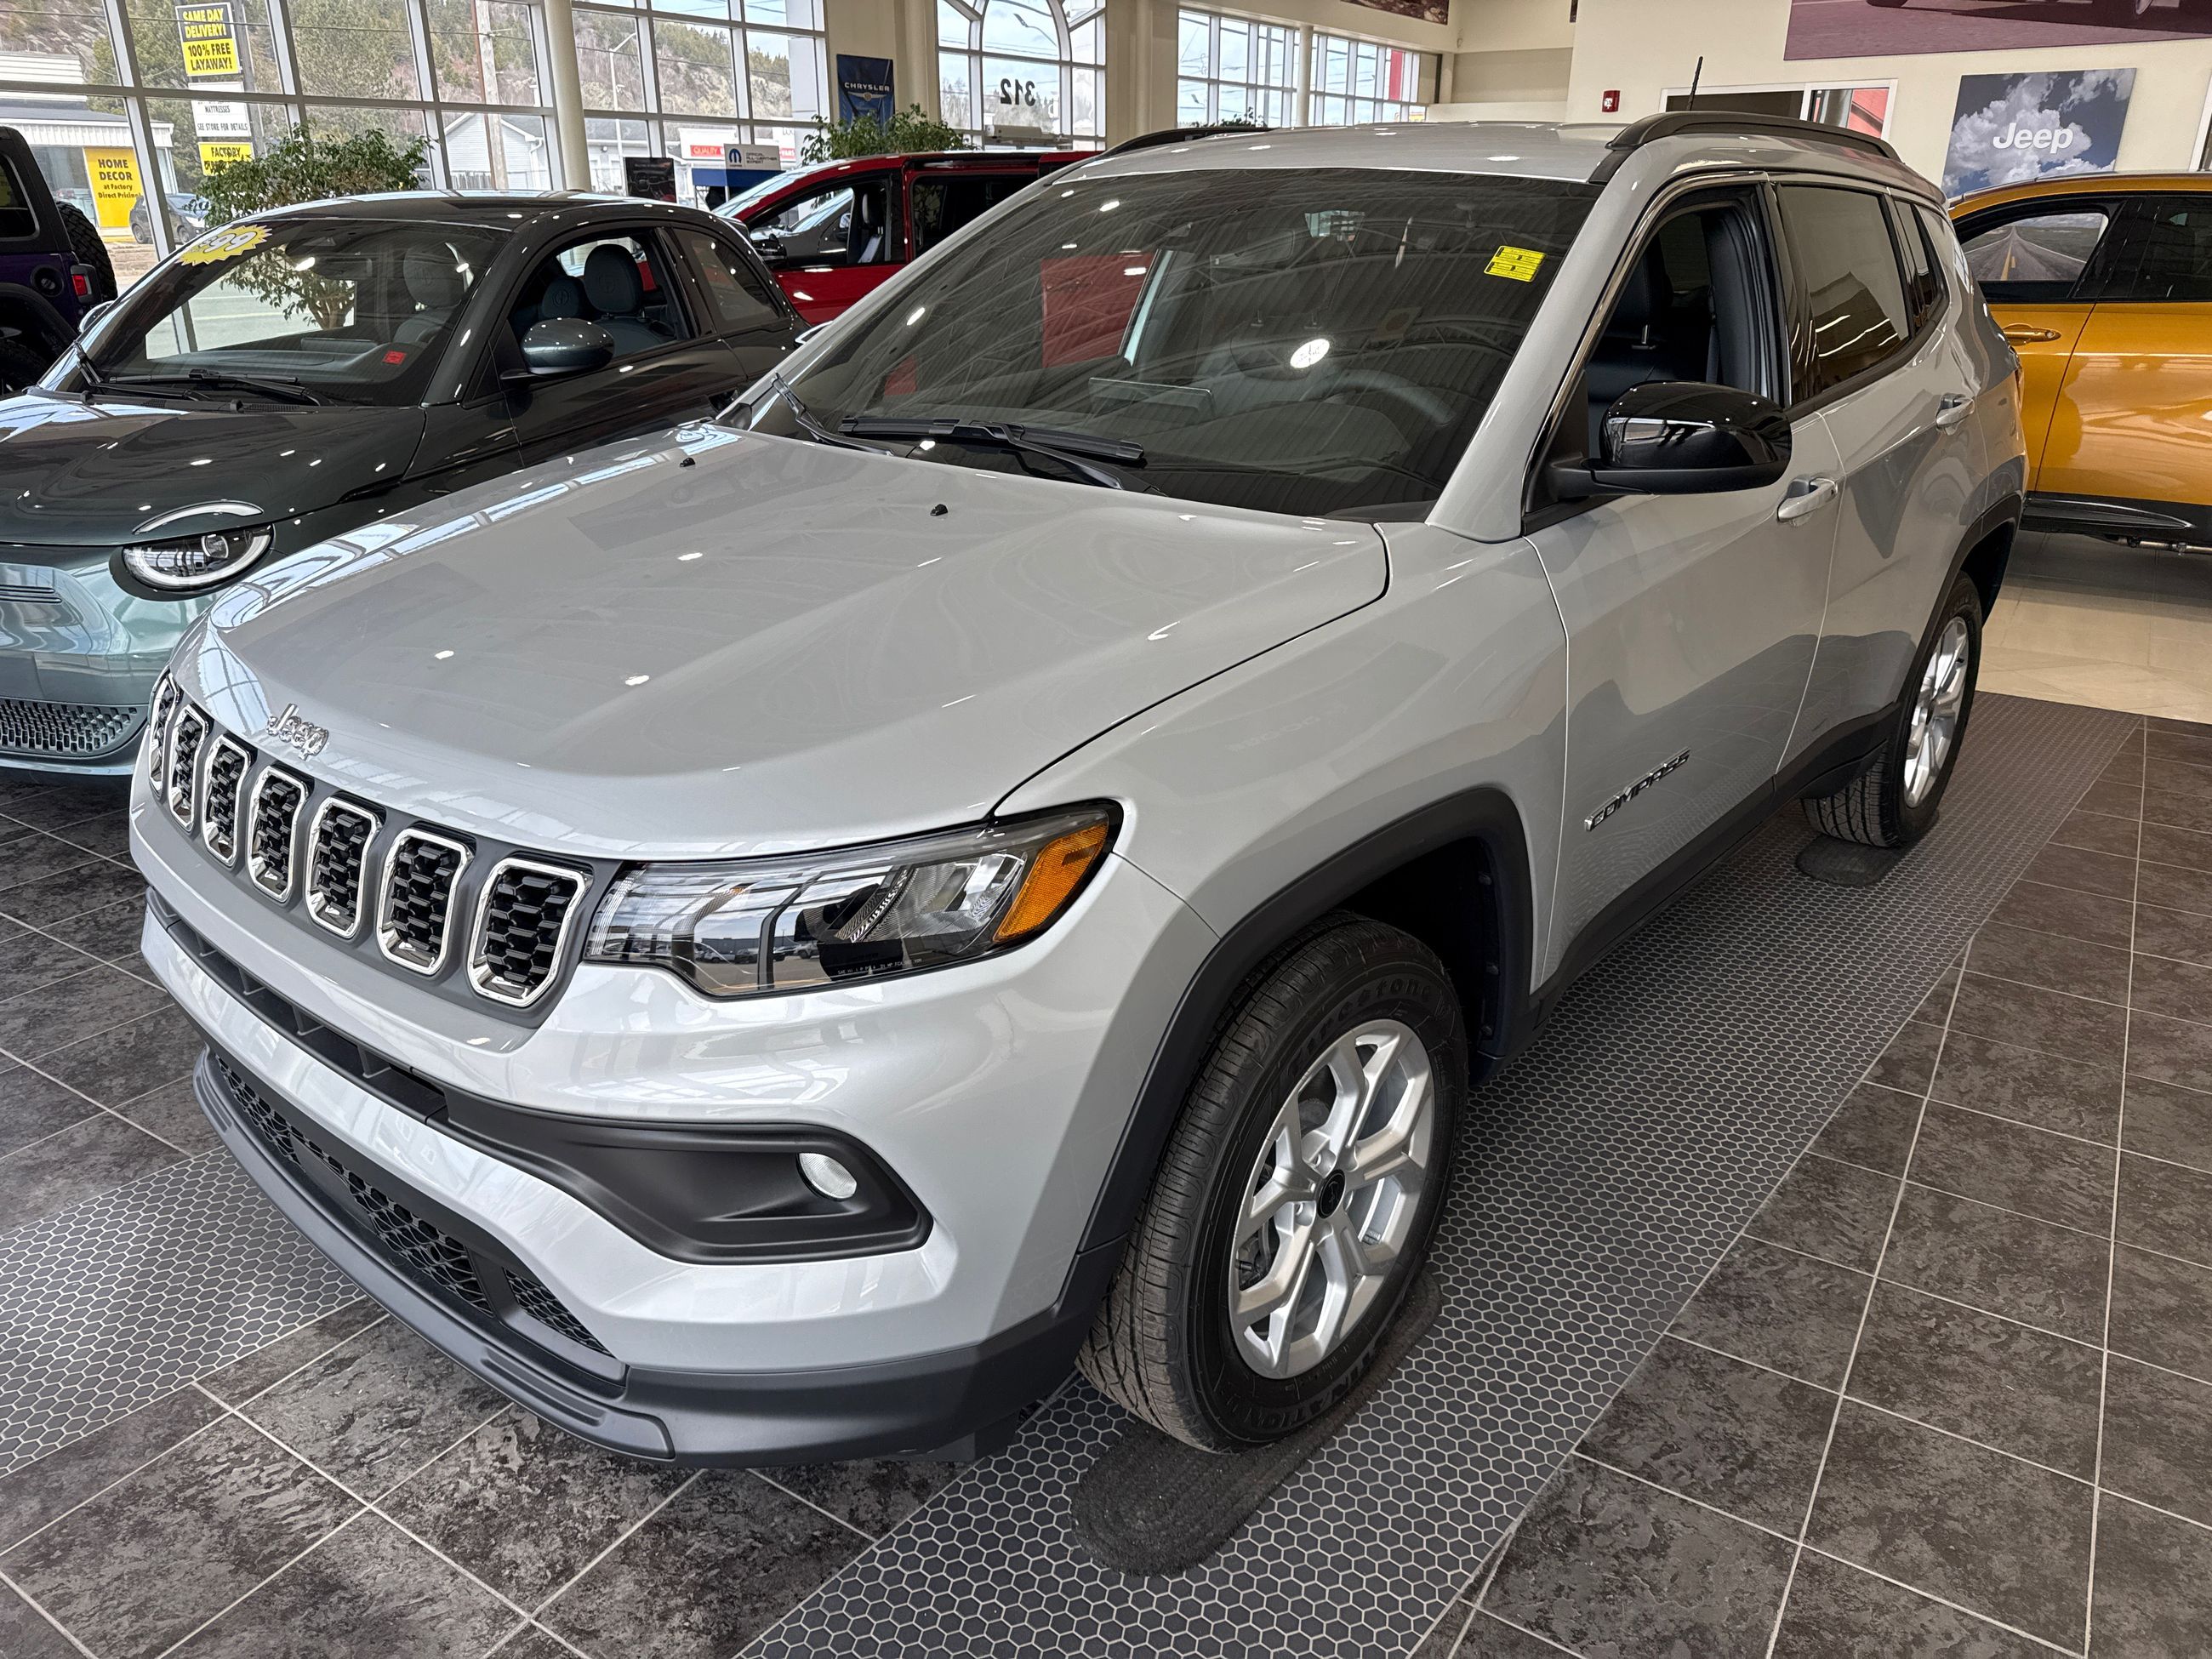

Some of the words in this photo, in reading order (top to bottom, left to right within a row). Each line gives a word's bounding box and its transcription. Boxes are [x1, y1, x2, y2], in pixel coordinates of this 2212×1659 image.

[182, 9, 207, 24] SAME
[207, 8, 224, 22] DAY
[185, 24, 227, 38] DELIVERY!
[188, 43, 210, 57] 100%
[211, 43, 231, 56] FREE
[190, 57, 233, 71] LAYAWAY!
[844, 82, 890, 92] CHRYSLER
[204, 105, 231, 113] MATTRESSES
[205, 123, 220, 131] STORE
[220, 123, 229, 131] FOR
[230, 123, 248, 131] DETAILS
[1993, 122, 2074, 154] Jeep
[210, 146, 241, 158] FACTORY
[693, 147, 718, 156] QUALITY
[98, 159, 128, 168] HOME
[99, 171, 133, 180] DECOR
[265, 703, 329, 761] Jeep
[1584, 746, 1691, 832] COMPASS
